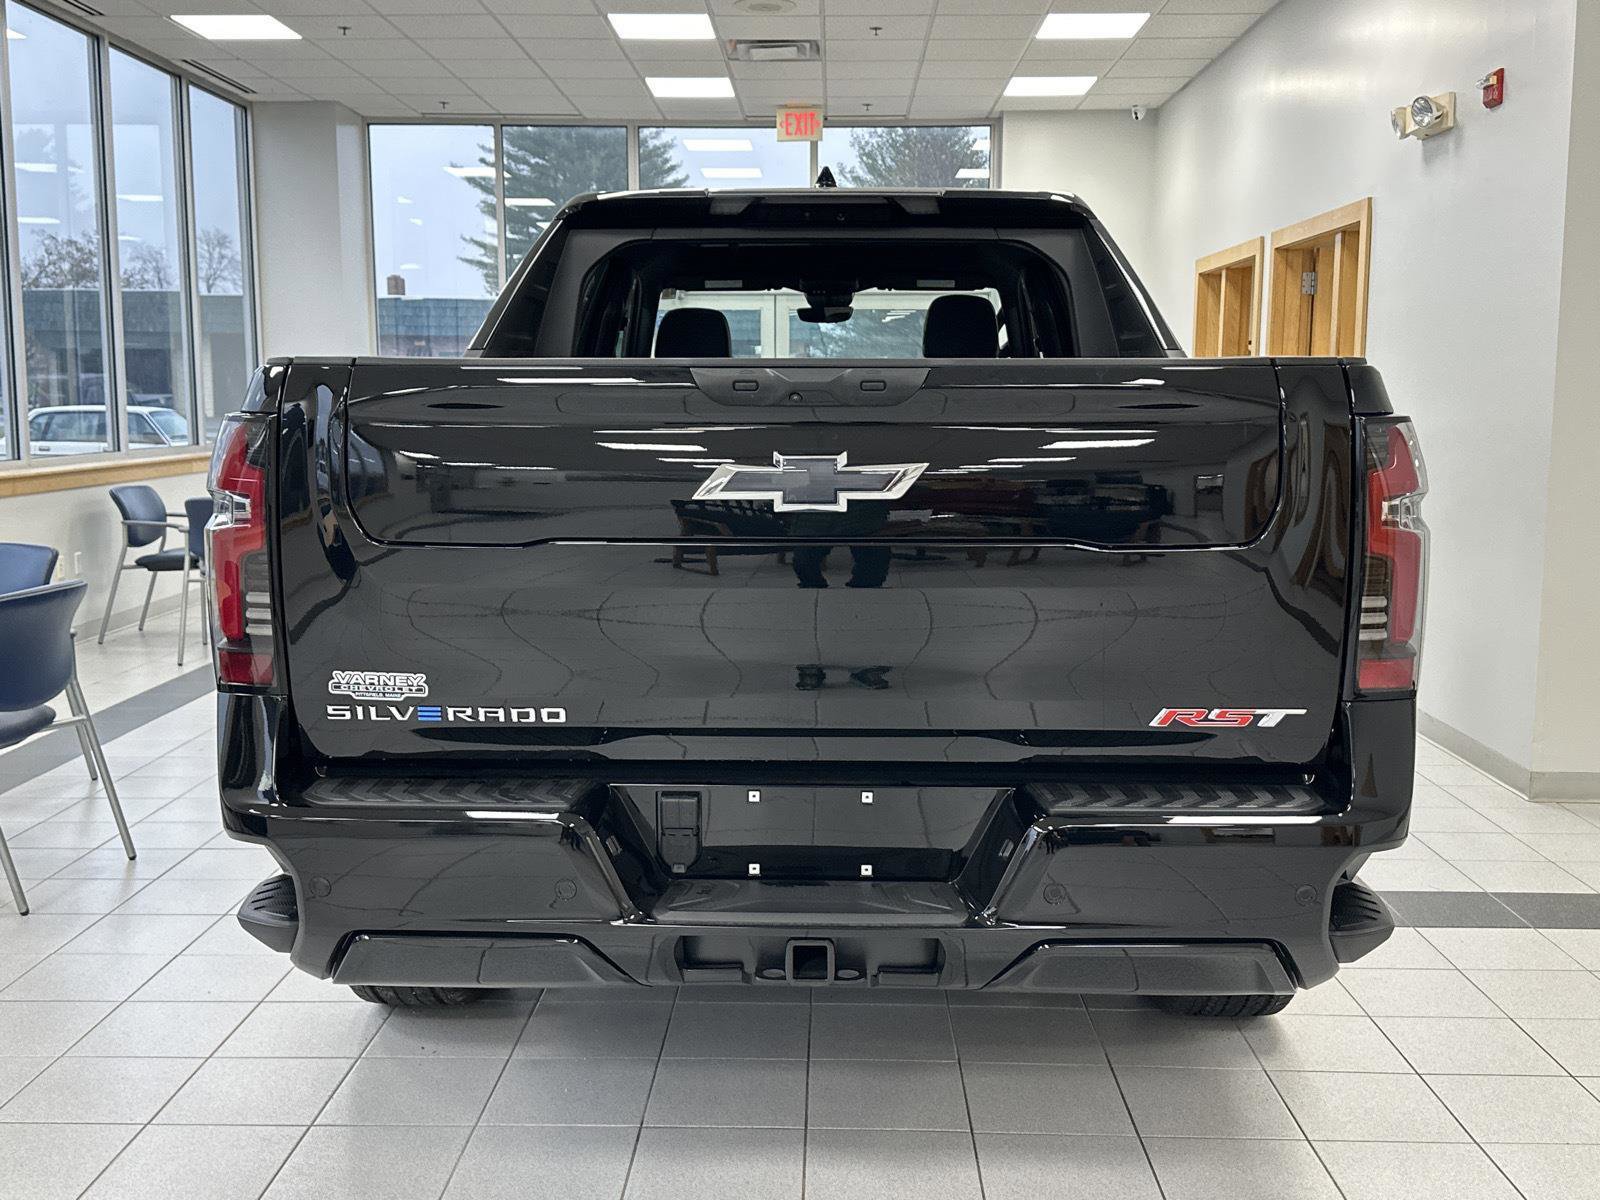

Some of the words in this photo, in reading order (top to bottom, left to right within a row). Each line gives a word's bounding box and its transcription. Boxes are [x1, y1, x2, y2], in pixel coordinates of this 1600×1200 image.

[784, 111, 816, 137] EXIT
[334, 673, 424, 687] VARNEY
[340, 684, 419, 693] CHEVROLET
[326, 704, 567, 723] SILVERADO
[1148, 708, 1308, 727] RST
